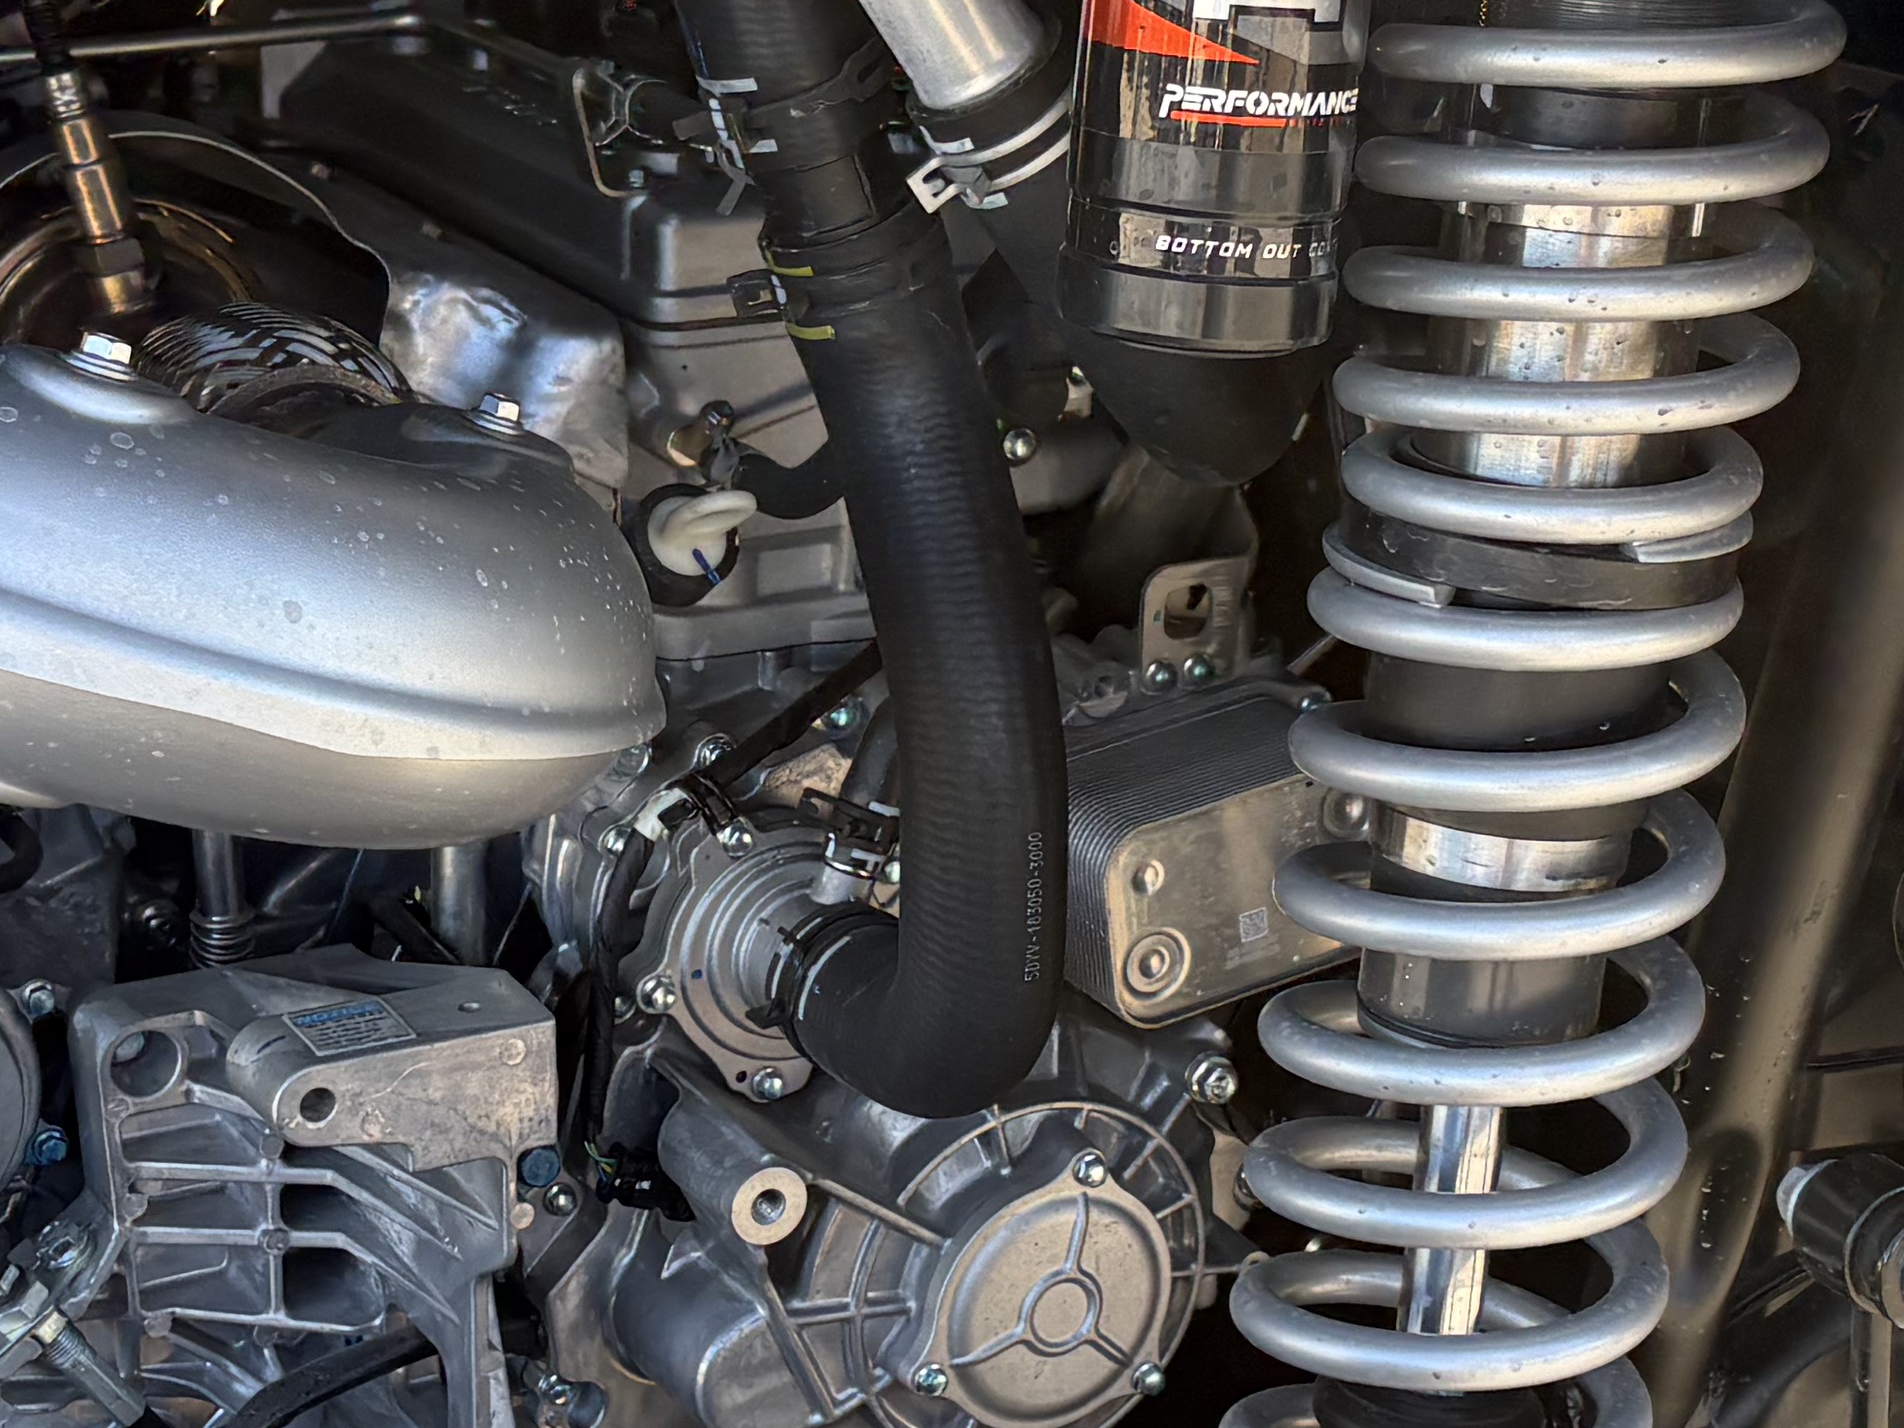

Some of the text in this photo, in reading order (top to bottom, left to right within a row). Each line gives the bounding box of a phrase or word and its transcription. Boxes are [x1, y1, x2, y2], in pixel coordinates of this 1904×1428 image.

[1158, 83, 1360, 118] PERFORMANCE
[1155, 234, 1254, 259] BOTTOM
[1262, 243, 1302, 260] OUT
